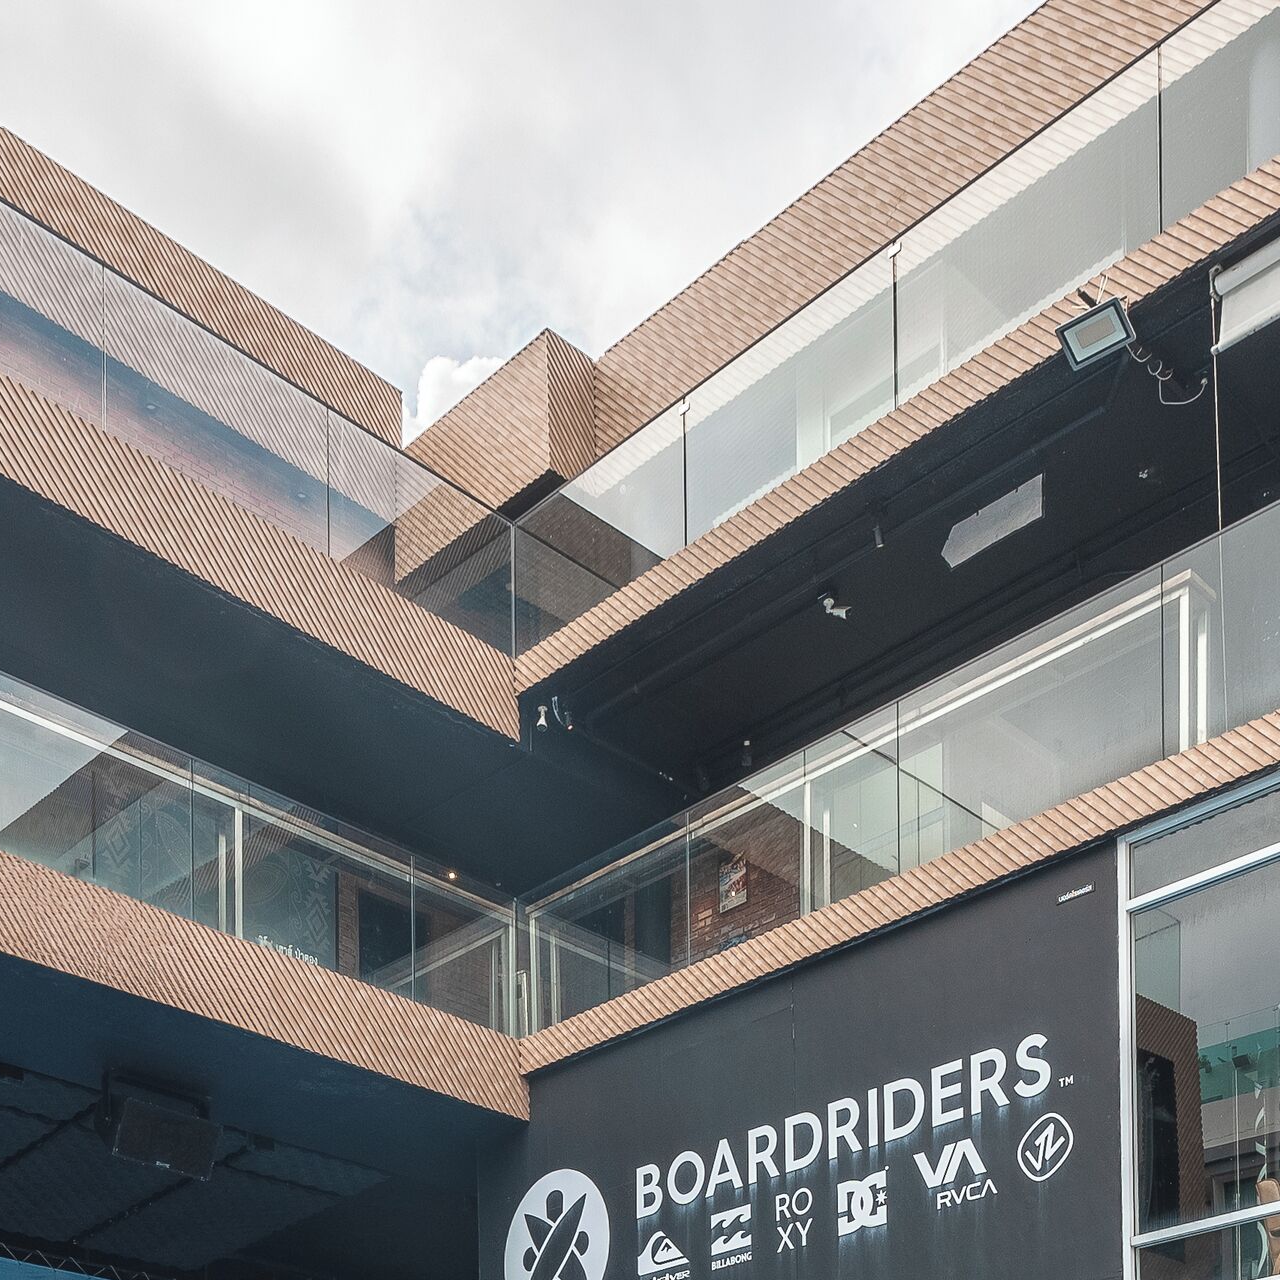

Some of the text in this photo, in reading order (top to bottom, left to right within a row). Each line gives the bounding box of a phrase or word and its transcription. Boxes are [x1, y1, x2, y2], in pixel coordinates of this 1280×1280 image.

[637, 1033, 1051, 1219] BOARDRIDERS
[936, 1179, 998, 1210] RVCA
[711, 1252, 753, 1271] BILLABONG
